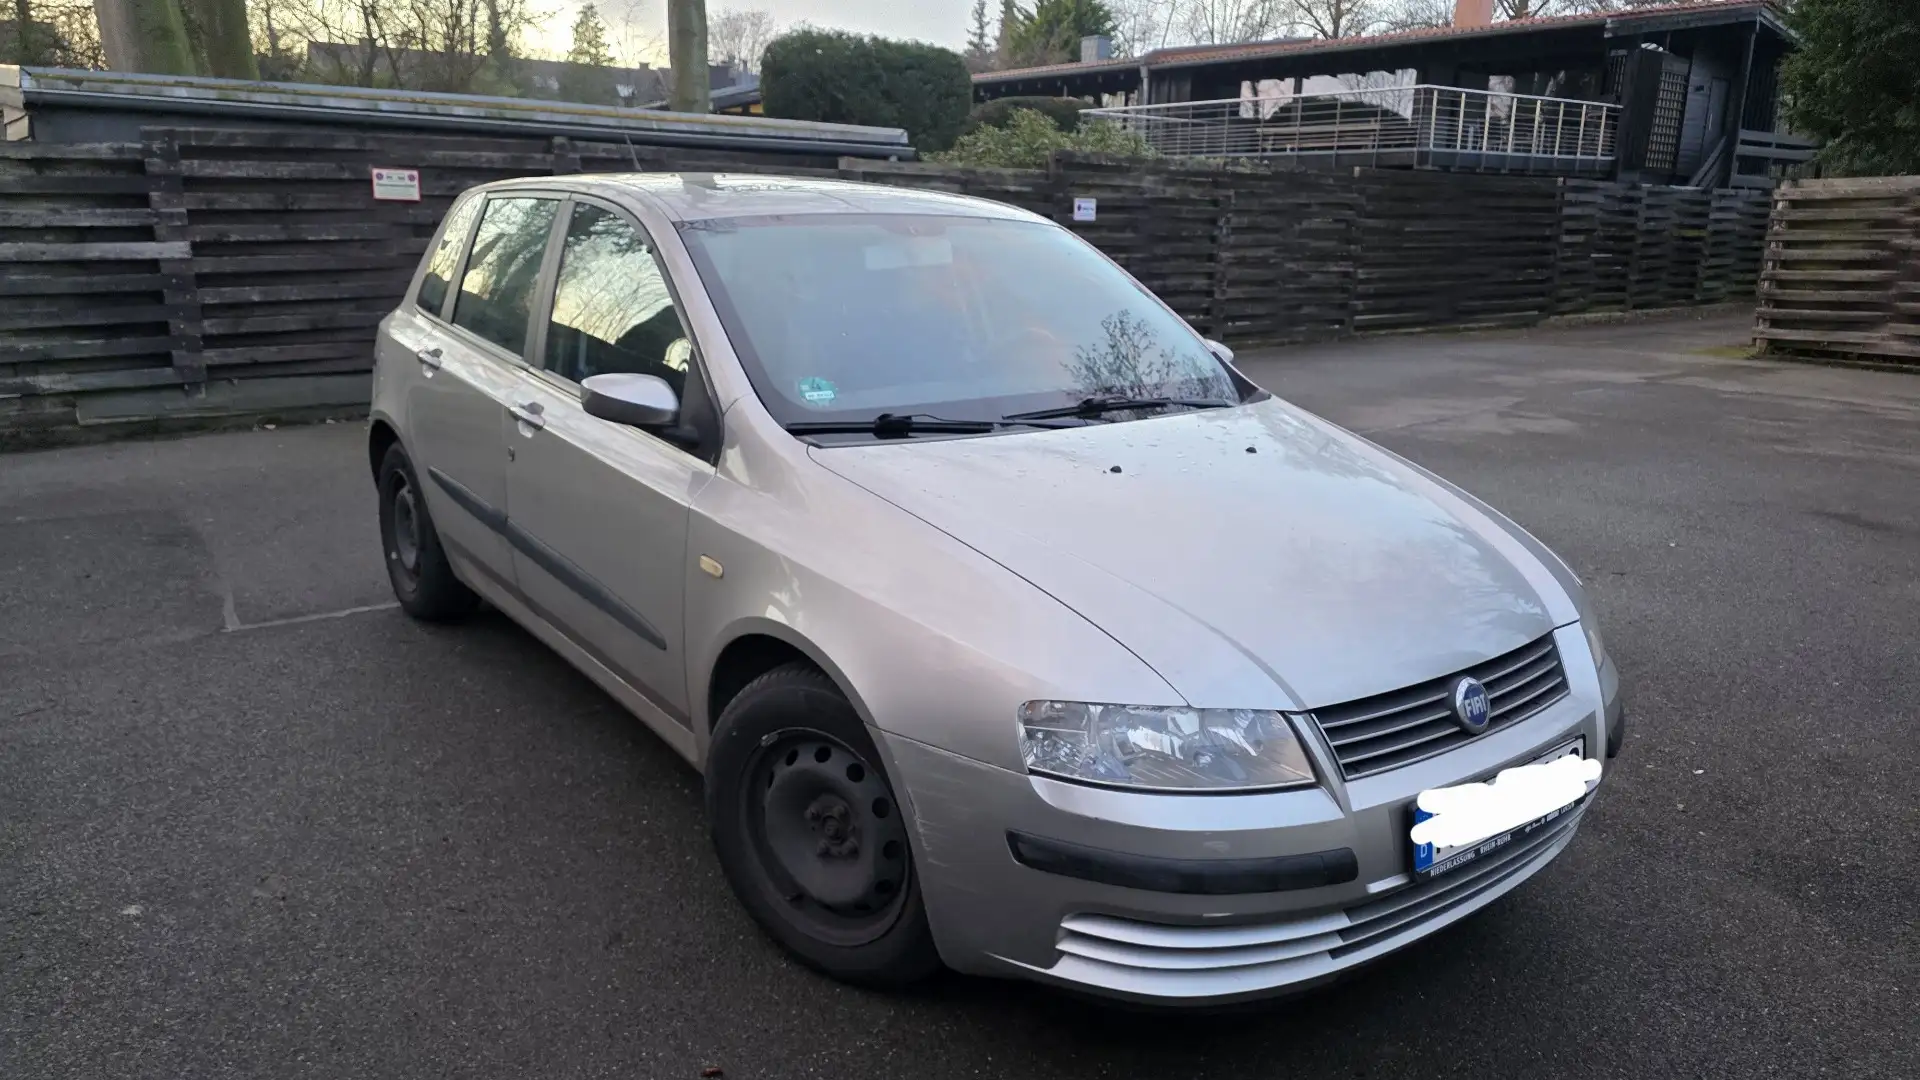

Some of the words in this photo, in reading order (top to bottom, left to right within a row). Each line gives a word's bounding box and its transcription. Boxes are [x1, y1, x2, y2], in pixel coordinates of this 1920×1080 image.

[1465, 693, 1487, 718] FIAT
[1420, 844, 1428, 858] D
[1430, 851, 1476, 877] NIEDERLASSUNG
